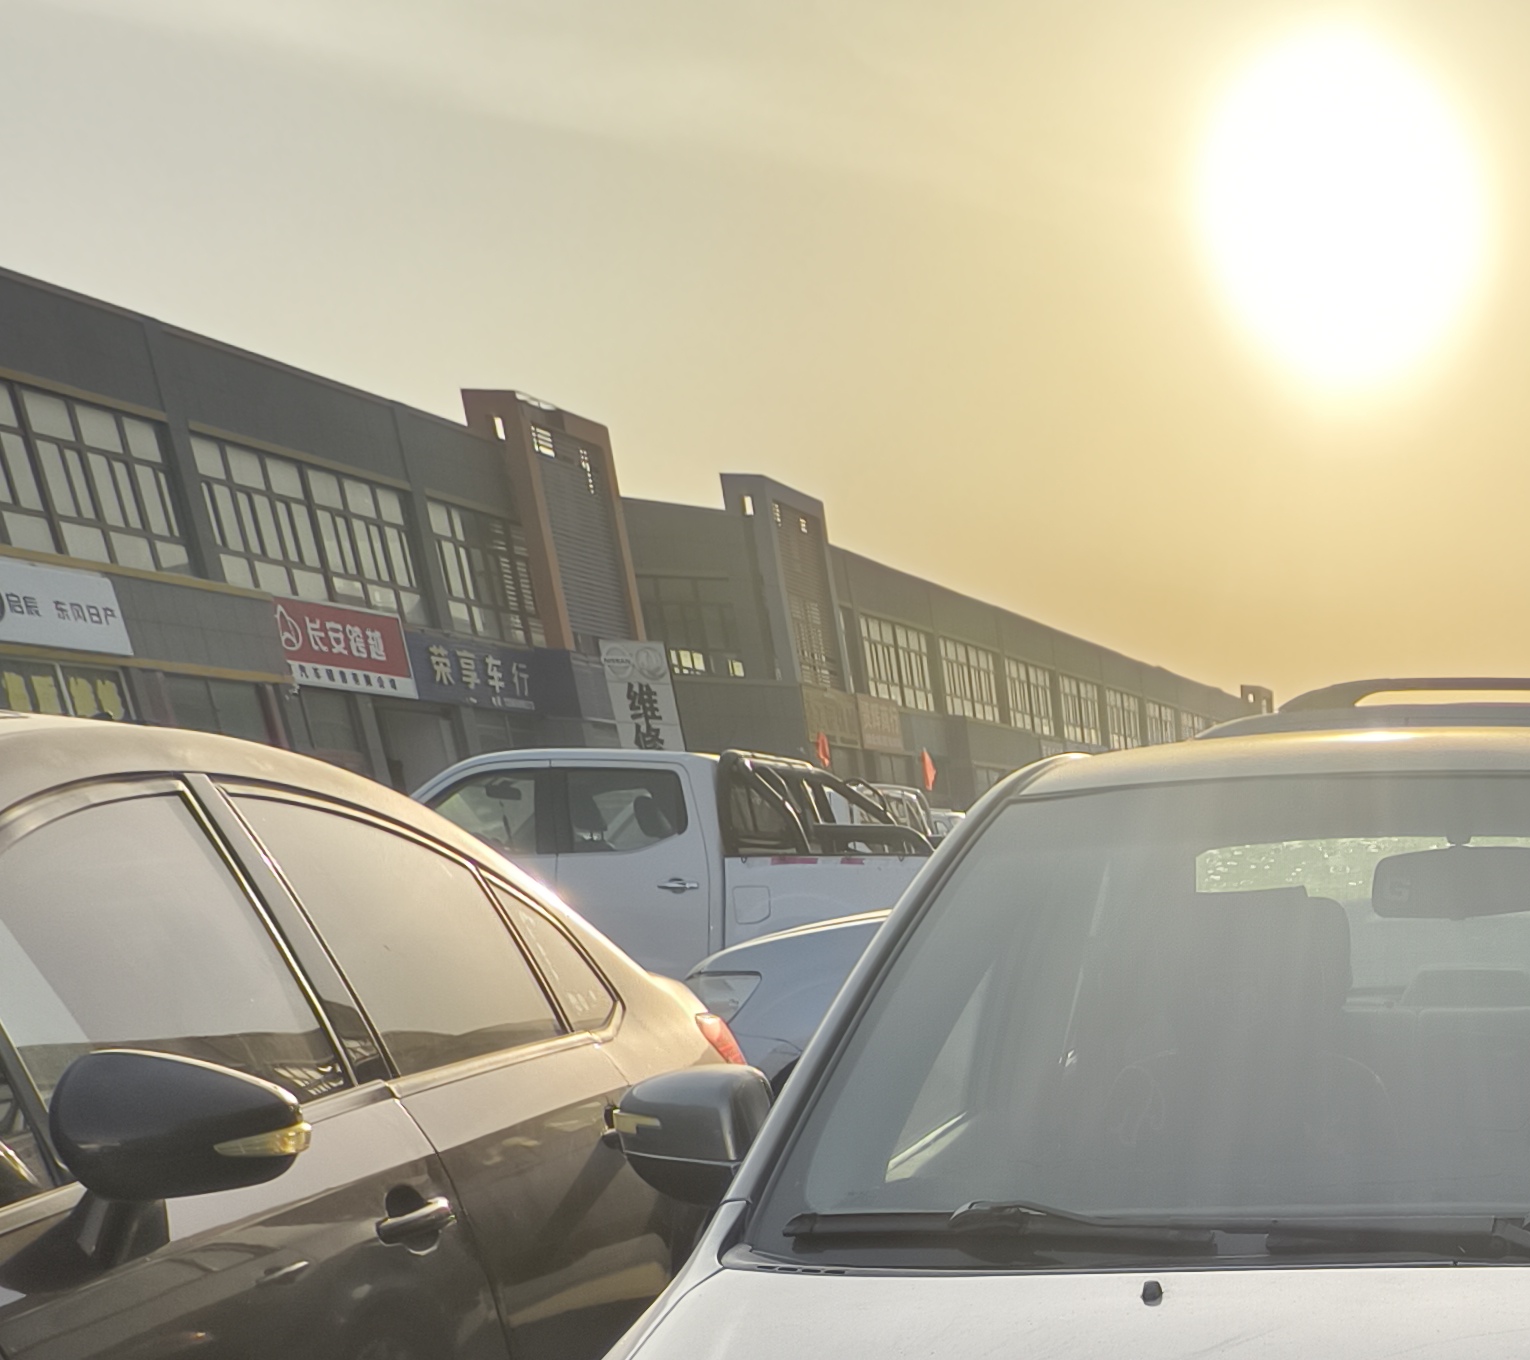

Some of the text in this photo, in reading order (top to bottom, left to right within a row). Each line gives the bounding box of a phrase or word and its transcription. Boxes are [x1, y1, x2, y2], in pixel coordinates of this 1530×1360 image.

[53, 600, 117, 626] 东风日产
[304, 616, 387, 661] 长安跨越
[428, 644, 530, 697] 荣享车行
[626, 681, 665, 750] 维修
